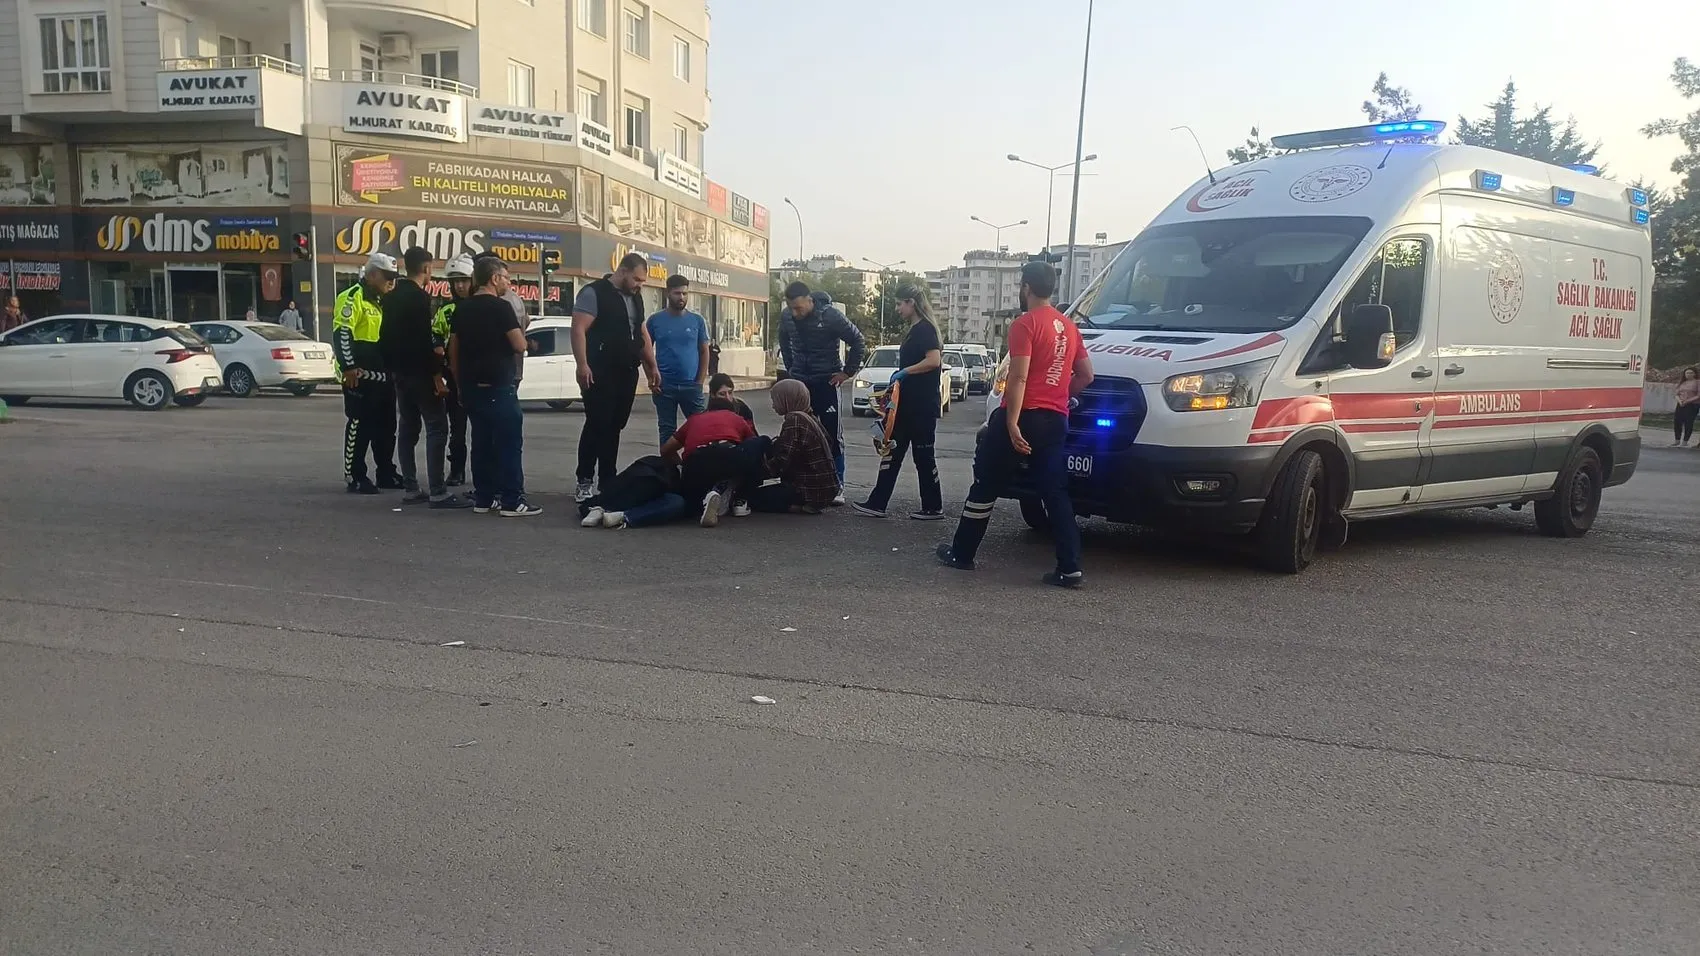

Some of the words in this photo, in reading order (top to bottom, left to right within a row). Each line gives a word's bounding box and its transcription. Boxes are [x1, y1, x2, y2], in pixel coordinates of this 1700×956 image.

[169, 76, 248, 90] AVUKAT
[161, 97, 205, 106] M.MURAT
[209, 95, 256, 106] KARATAŞ
[357, 90, 451, 113] AVUKAT
[349, 116, 403, 129] M.MURAT
[408, 120, 457, 138] KARATAŞ
[480, 107, 564, 127] AVUKAT
[581, 122, 611, 144] AVUKAT
[413, 176, 431, 188] EN
[512, 171, 553, 184] HALKA
[421, 192, 439, 204] EN
[441, 194, 486, 208] UYGUN
[488, 198, 561, 214] FIYATLARLA
[142, 213, 212, 252] dms
[215, 229, 280, 253] mobilya
[399, 219, 485, 260] dms
[1592, 258, 1608, 281] T.C.
[1557, 279, 1590, 307] SAĞLIK
[1594, 286, 1636, 311] BAKANLIĞI
[1569, 311, 1589, 337] ACİL
[1593, 313, 1623, 339] SAĞLIK
[1629, 354, 1642, 371] 112
[1459, 393, 1521, 413] AMBULANS
[1067, 455, 1090, 472] 660
